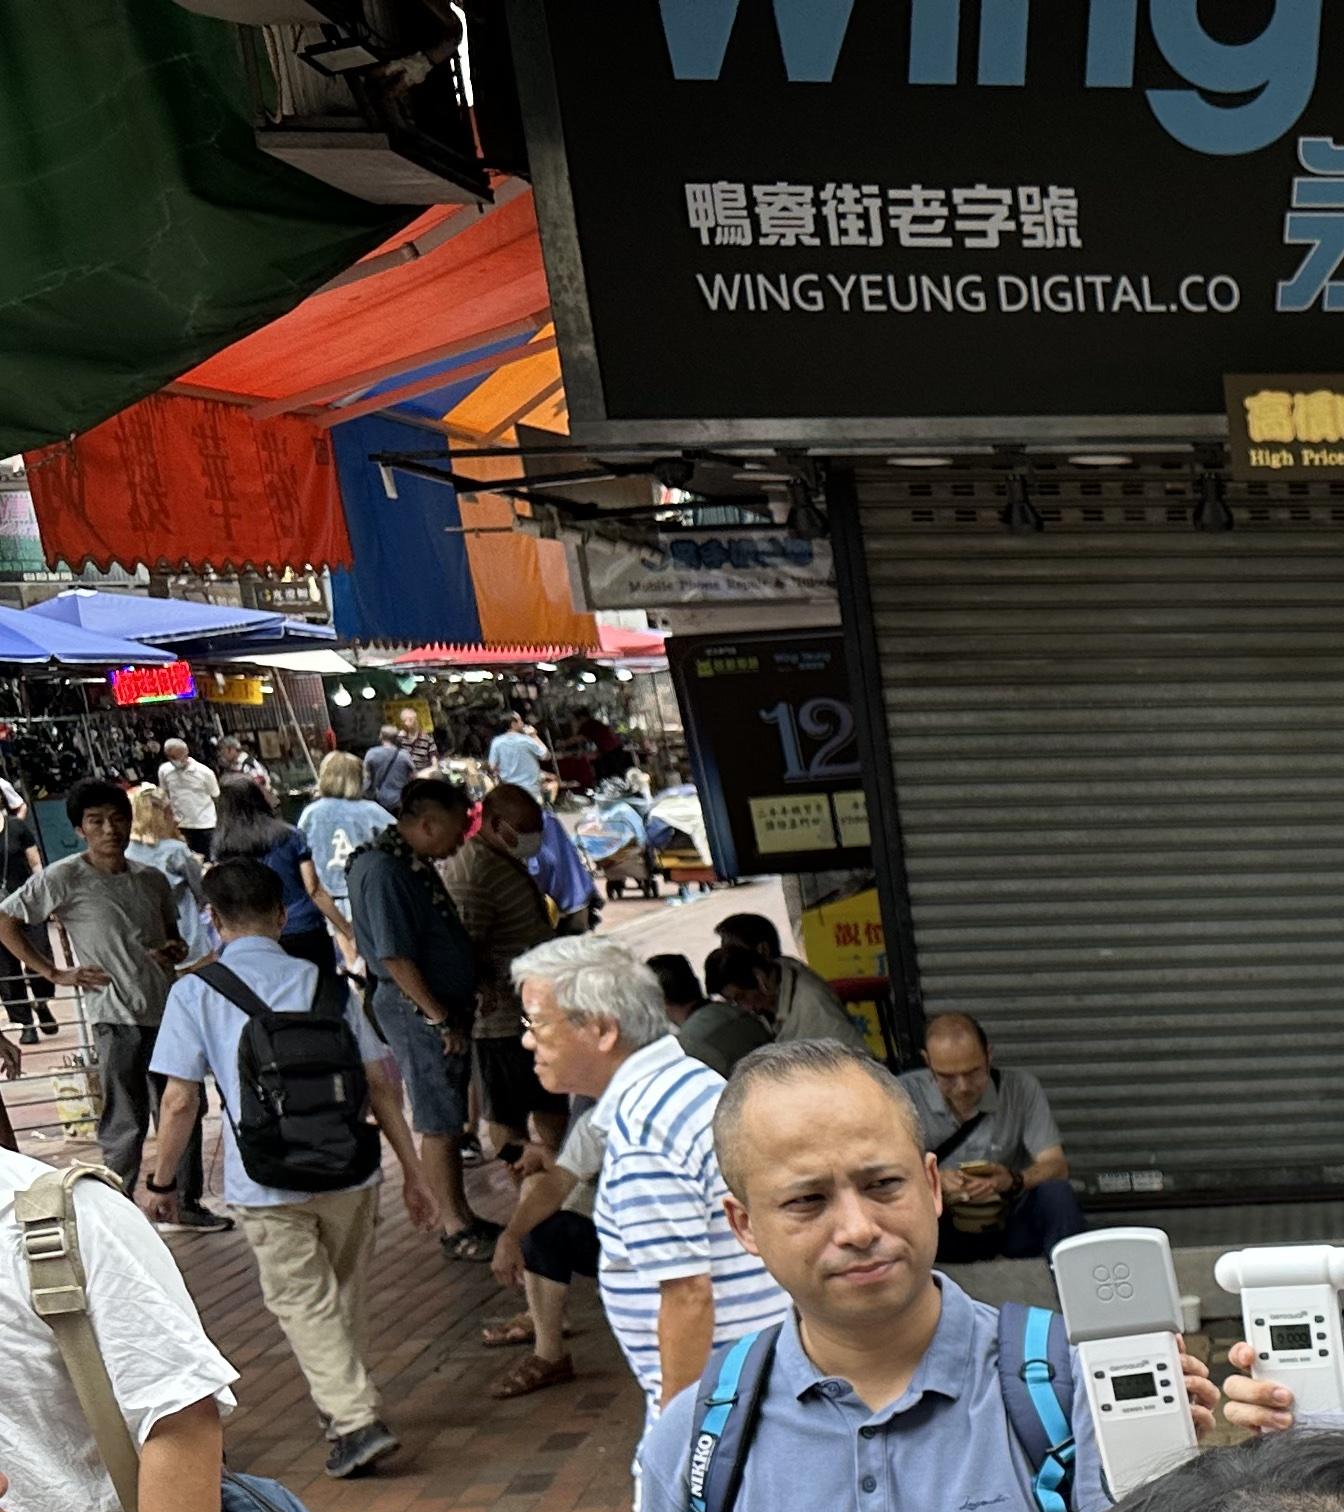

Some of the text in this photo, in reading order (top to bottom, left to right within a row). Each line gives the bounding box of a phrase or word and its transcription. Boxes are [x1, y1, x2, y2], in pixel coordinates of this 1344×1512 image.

[684, 180, 1084, 250] 鴨寮街老字號
[696, 273, 1241, 314] WING YEUNG DIGITAL.CO
[1251, 450, 1295, 468] High
[690, 1433, 715, 1498] NIKKO
